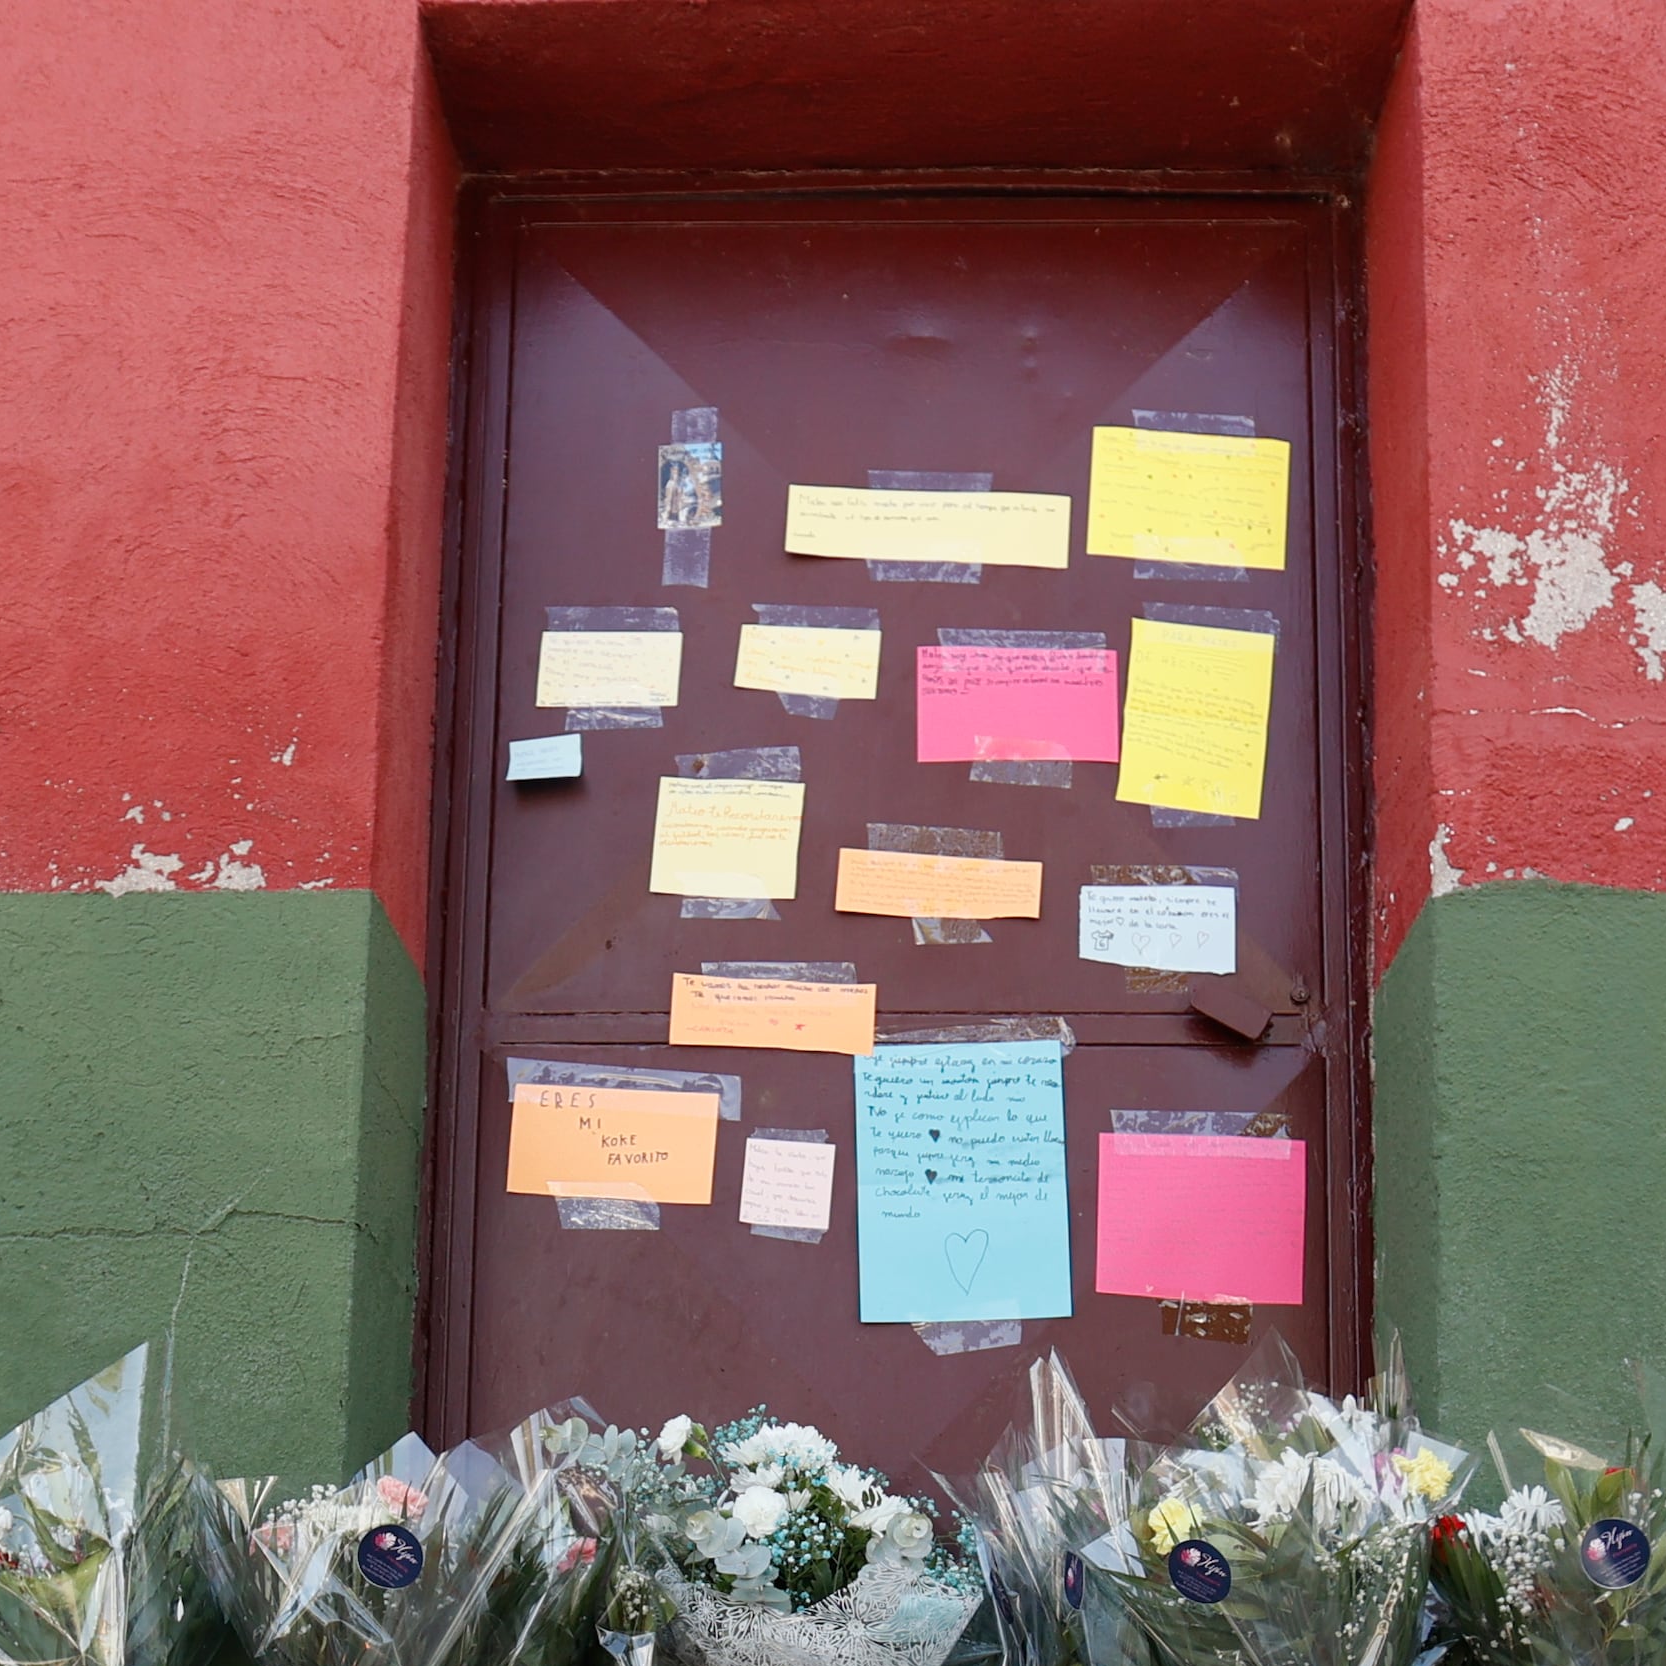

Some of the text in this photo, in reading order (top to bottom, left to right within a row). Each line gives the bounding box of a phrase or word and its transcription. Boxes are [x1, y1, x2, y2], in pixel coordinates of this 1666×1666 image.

[539, 1090, 597, 1109] ERES
[578, 1116, 602, 1131] MI
[911, 1112, 945, 1121] como
[1025, 1114, 1047, 1124] que
[970, 1131, 1006, 1150] puedo
[607, 1150, 670, 1166] FAVORITO
[881, 1204, 921, 1218] mundo
